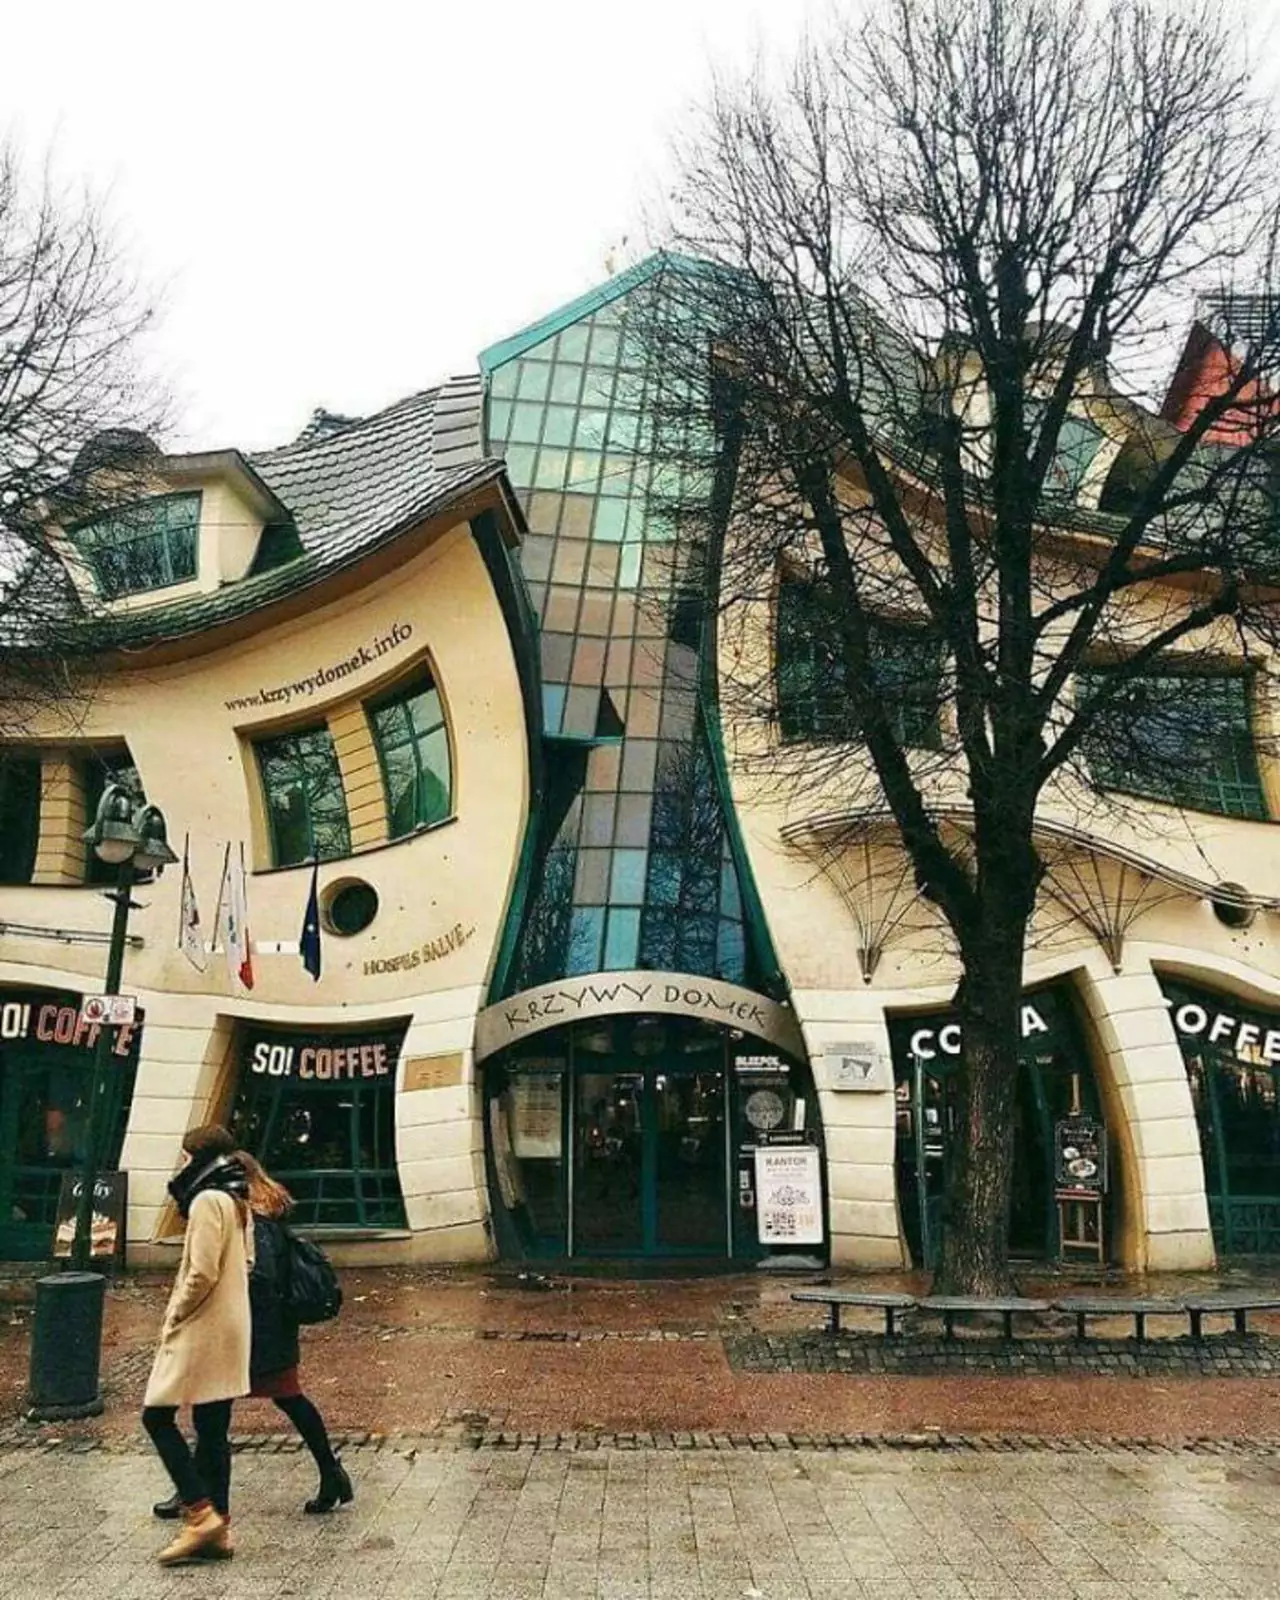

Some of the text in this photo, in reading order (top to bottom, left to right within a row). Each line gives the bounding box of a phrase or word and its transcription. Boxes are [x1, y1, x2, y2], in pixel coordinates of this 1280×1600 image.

[224, 623, 413, 711] www.krzywydomek.info
[0, 1002, 134, 1057] O! COFFE
[504, 976, 767, 1030] KRZYWY DOMEK
[1160, 997, 1280, 1062] OFFE
[910, 1004, 1049, 1060] COA
[252, 1042, 390, 1080] SO! COFFEE
[765, 1157, 807, 1166] KANTOR
